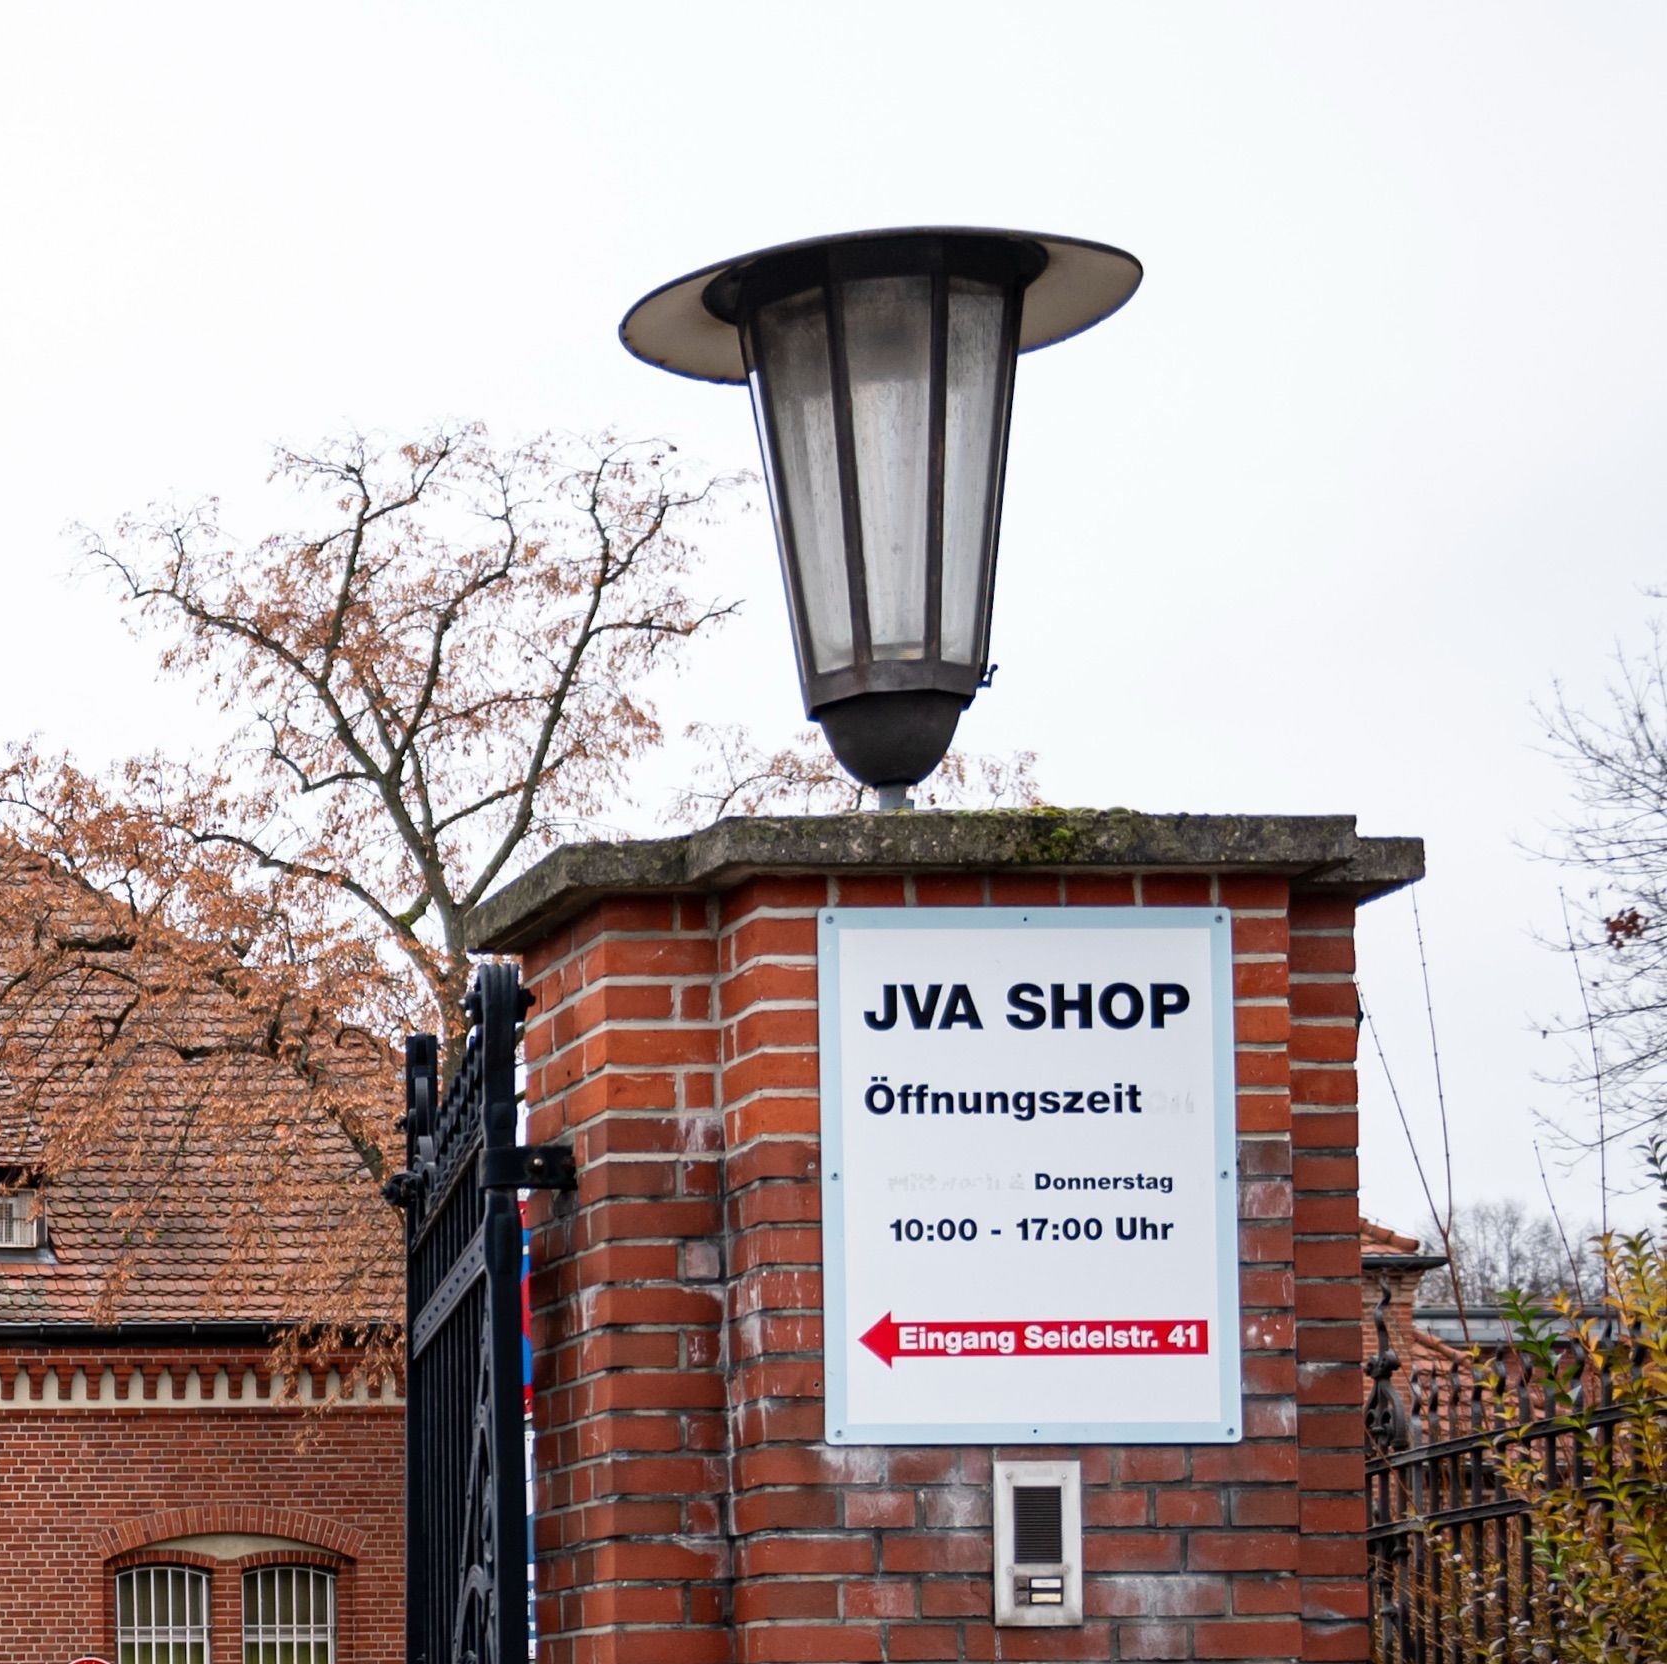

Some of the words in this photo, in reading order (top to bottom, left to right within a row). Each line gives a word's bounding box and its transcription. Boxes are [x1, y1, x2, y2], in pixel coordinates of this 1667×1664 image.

[863, 983, 984, 1031] JVA
[1005, 982, 1191, 1030] SHOP
[864, 1076, 1142, 1121] Öffnungszeit
[1034, 1172, 1174, 1194] Donnerstag
[889, 1218, 978, 1242] 10:00
[1016, 1217, 1103, 1241] 17:00
[1115, 1216, 1175, 1241] Uhr
[898, 1325, 1015, 1354] Eingang
[1023, 1324, 1159, 1350] Seidelstr.
[1166, 1323, 1199, 1349] 41
